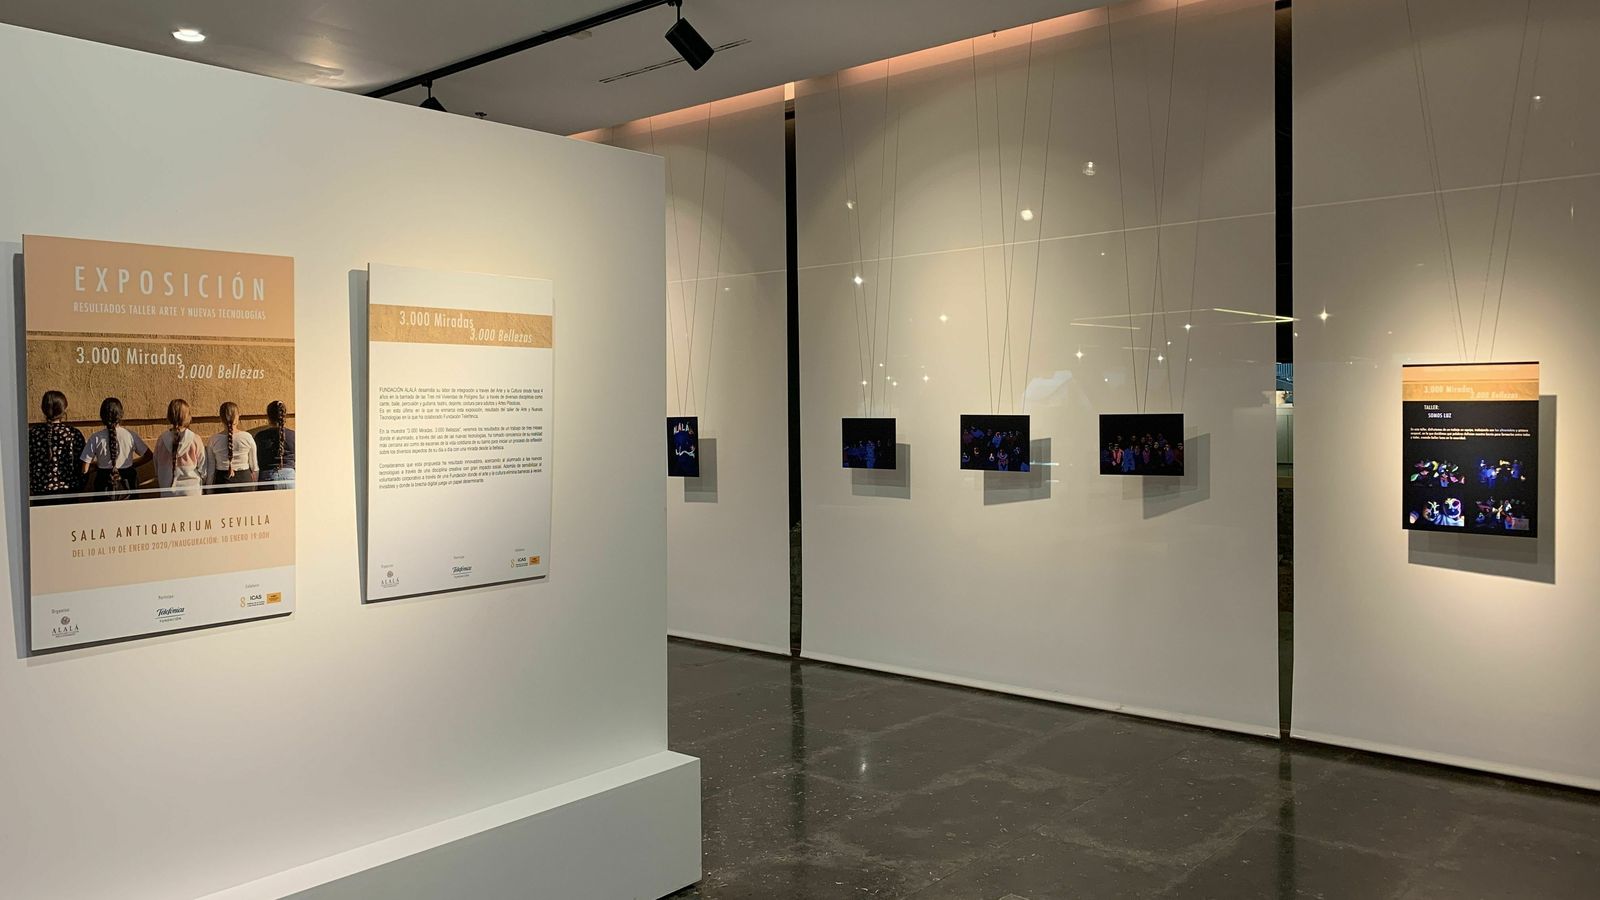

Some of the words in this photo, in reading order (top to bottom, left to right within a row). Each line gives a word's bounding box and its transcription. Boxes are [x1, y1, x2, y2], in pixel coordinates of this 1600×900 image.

[74, 265, 265, 301] EXPOSICIÓN
[74, 302, 126, 314] RESULTADOS
[129, 304, 156, 316] TALLER
[159, 306, 178, 316] ARTE
[180, 306, 185, 316] Y
[188, 307, 216, 318] NUEVAS
[218, 309, 266, 320] TECNOLOGÍAS
[400, 310, 430, 326] 3.000
[434, 313, 474, 328] Miradas
[470, 328, 496, 342] 3.000
[498, 329, 533, 344] Bellezas
[76, 347, 120, 365] 3.000
[126, 348, 184, 365] Miradas
[177, 364, 214, 380] 3.000
[217, 364, 265, 380] Bellezas
[71, 528, 106, 542] SALA
[116, 519, 212, 538] ANTIQUARIUM
[220, 514, 270, 529] SEVILLA
[72, 549, 84, 558] DEL
[88, 548, 96, 556] 10
[98, 547, 106, 556] AL
[108, 546, 116, 555] 19
[118, 545, 127, 554] DE
[128, 542, 150, 553] ENERO
[221, 534, 228, 543] 10
[230, 533, 249, 542] ENERO
